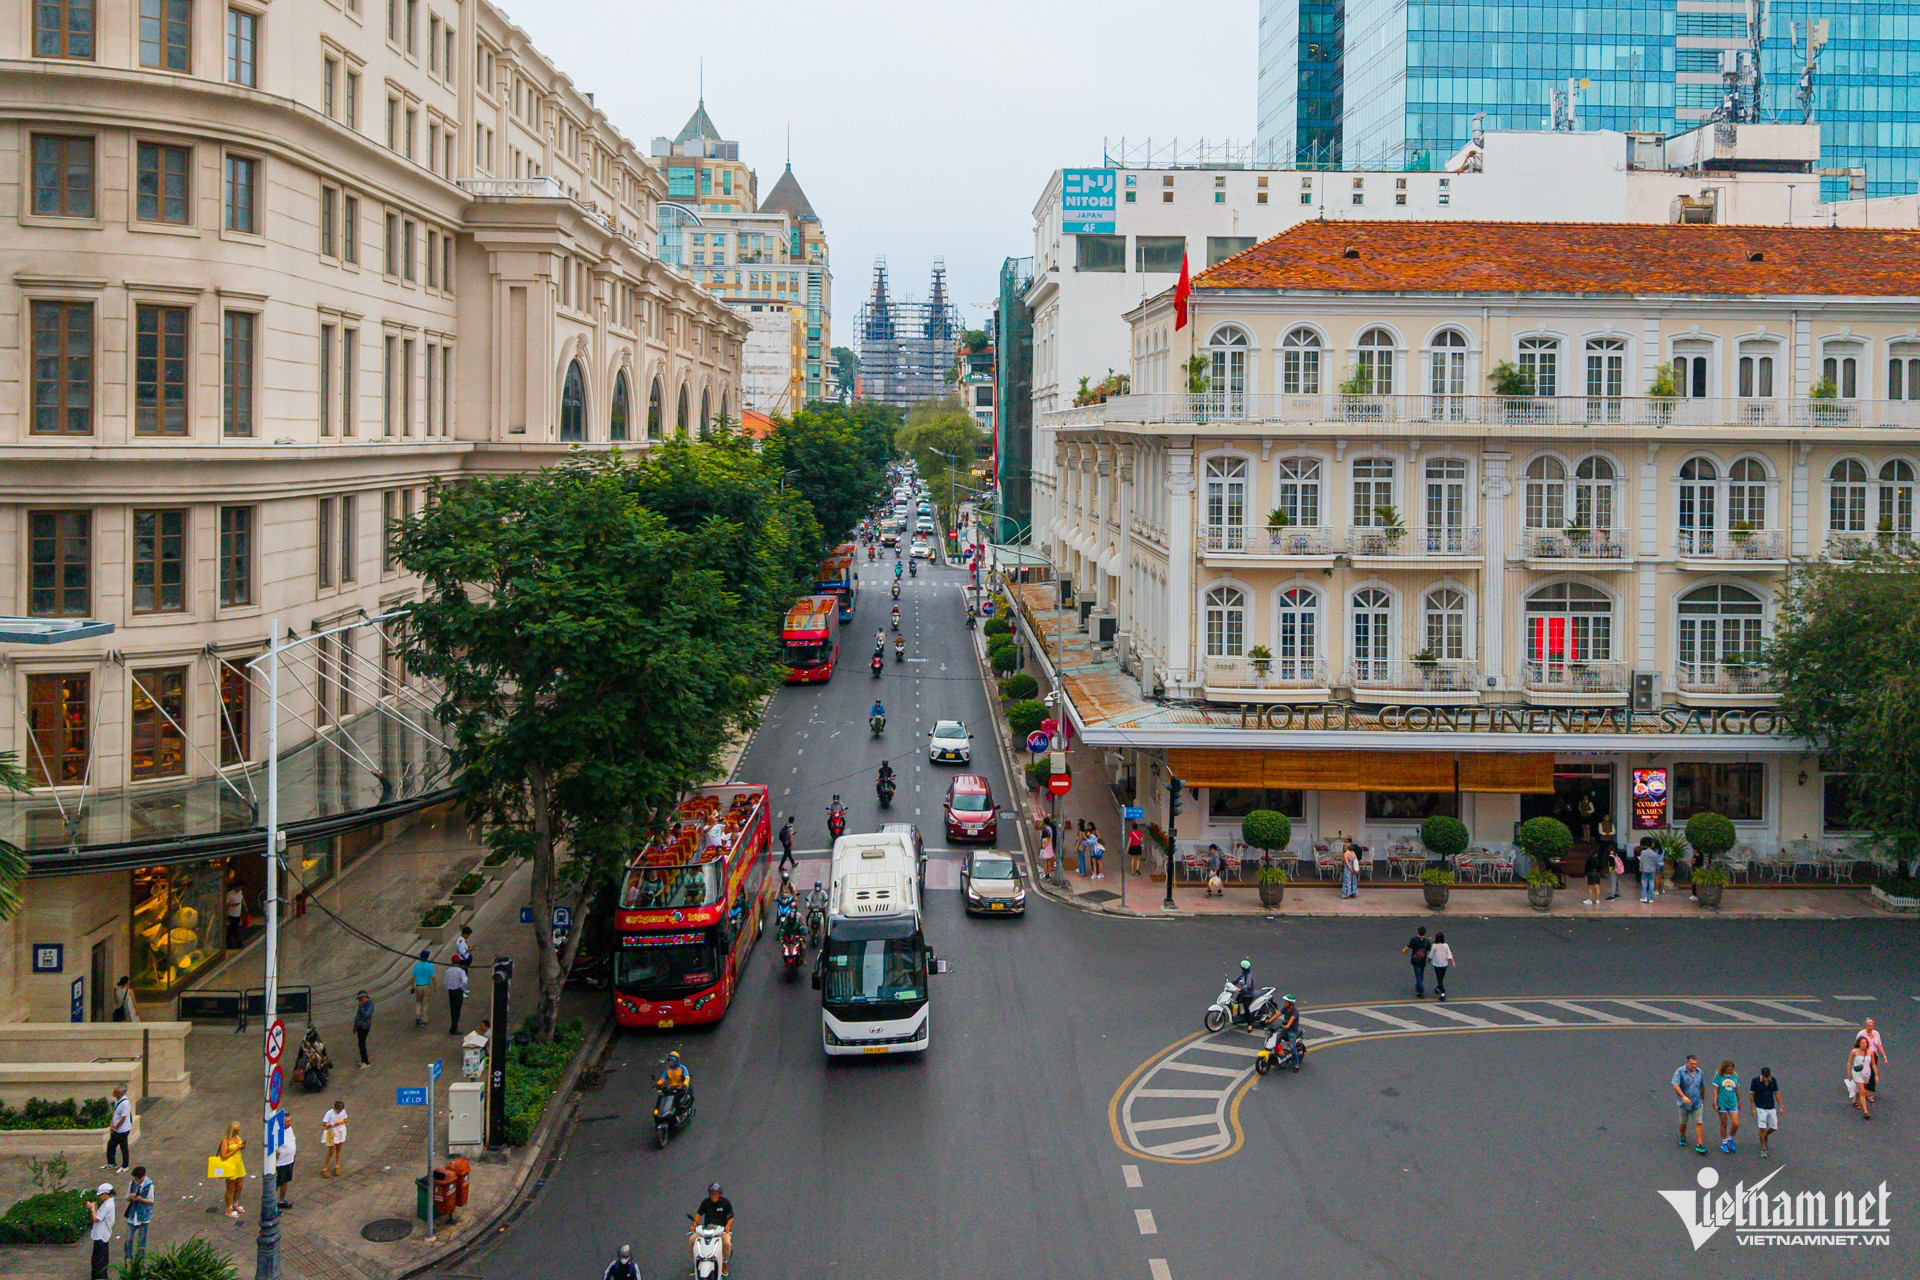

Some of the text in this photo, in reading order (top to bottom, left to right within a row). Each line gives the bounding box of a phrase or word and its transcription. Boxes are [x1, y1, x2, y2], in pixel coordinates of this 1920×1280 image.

[1065, 174, 1113, 193] ニトリ
[1065, 196, 1113, 207] NITORI
[1082, 223, 1096, 233] 4F
[1240, 704, 1360, 730] HOTEL
[1378, 706, 1641, 734] CONTINENTAL
[1029, 735, 1047, 747] Vikki
